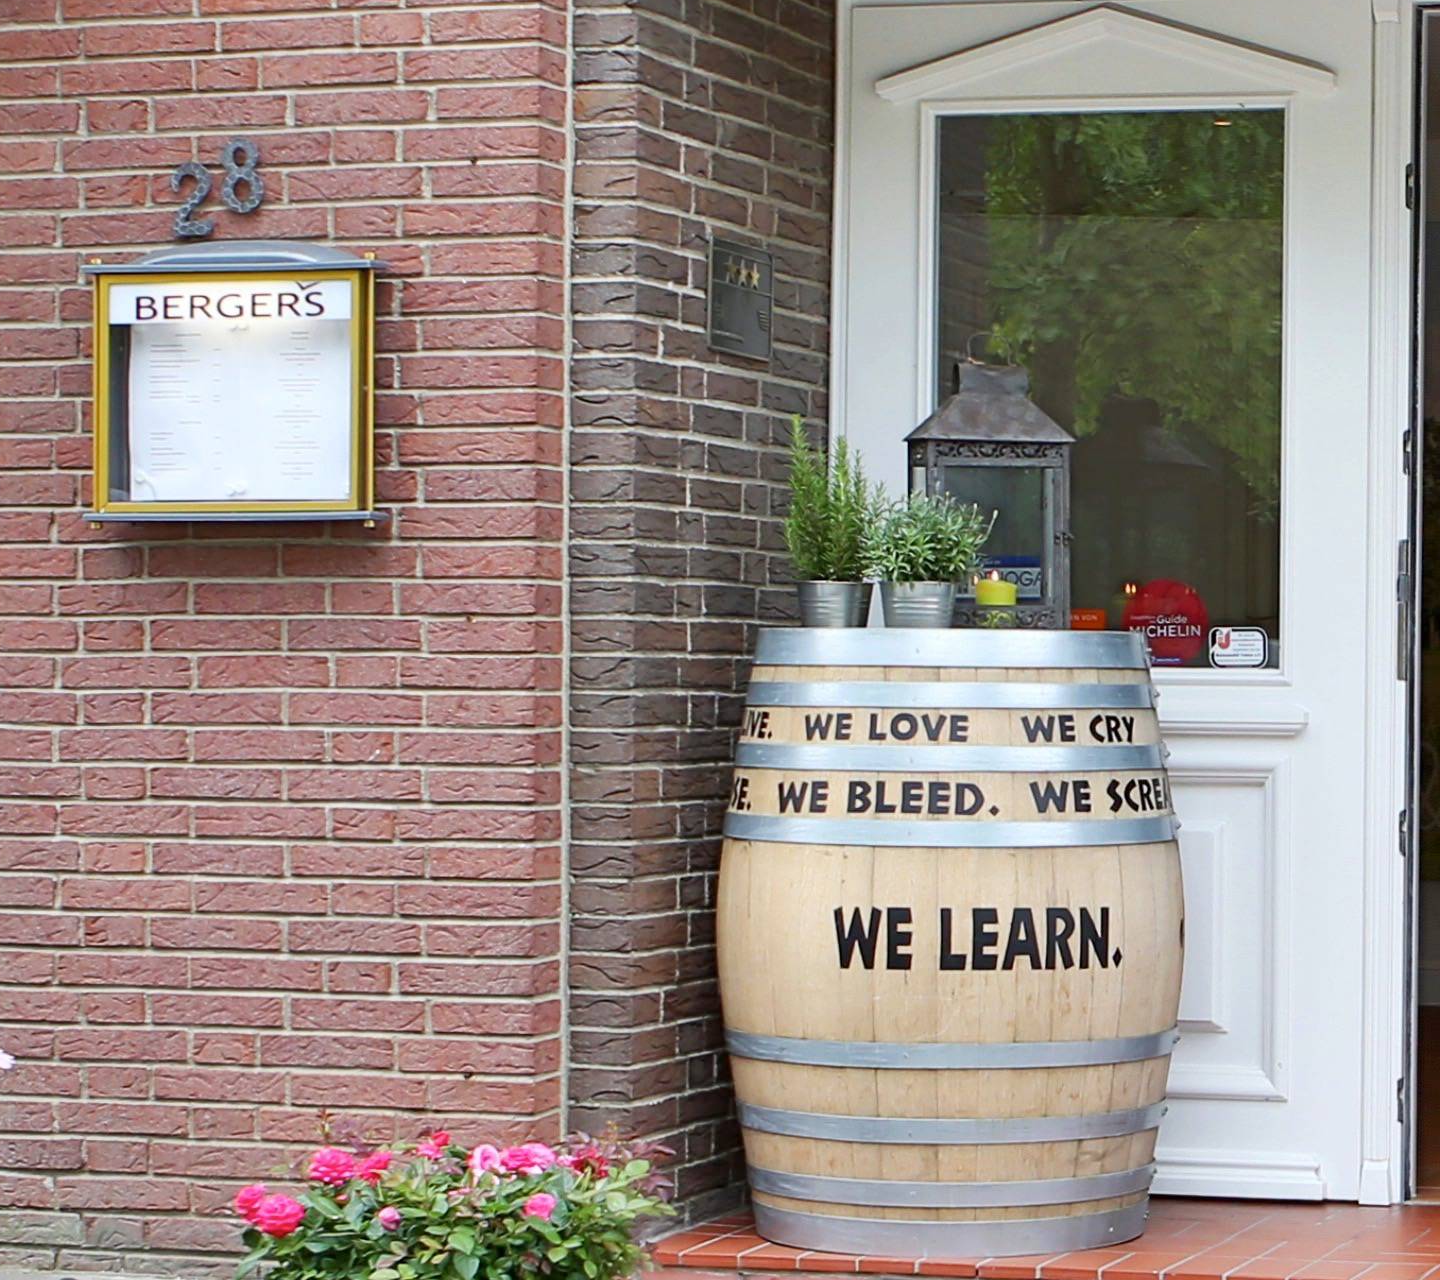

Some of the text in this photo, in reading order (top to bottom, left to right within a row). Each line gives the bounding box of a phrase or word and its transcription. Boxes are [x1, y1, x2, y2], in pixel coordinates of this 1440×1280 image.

[169, 137, 264, 237] 28
[1156, 614, 1188, 624] Guide
[804, 713, 852, 741] WE
[868, 713, 970, 742] LOVE
[1020, 714, 1076, 743] WE
[1089, 714, 1135, 743] CRY
[778, 781, 829, 813] WE
[846, 780, 1000, 817] BLEED.
[1029, 780, 1092, 813] WE
[833, 906, 1123, 971] WE LEARN.
